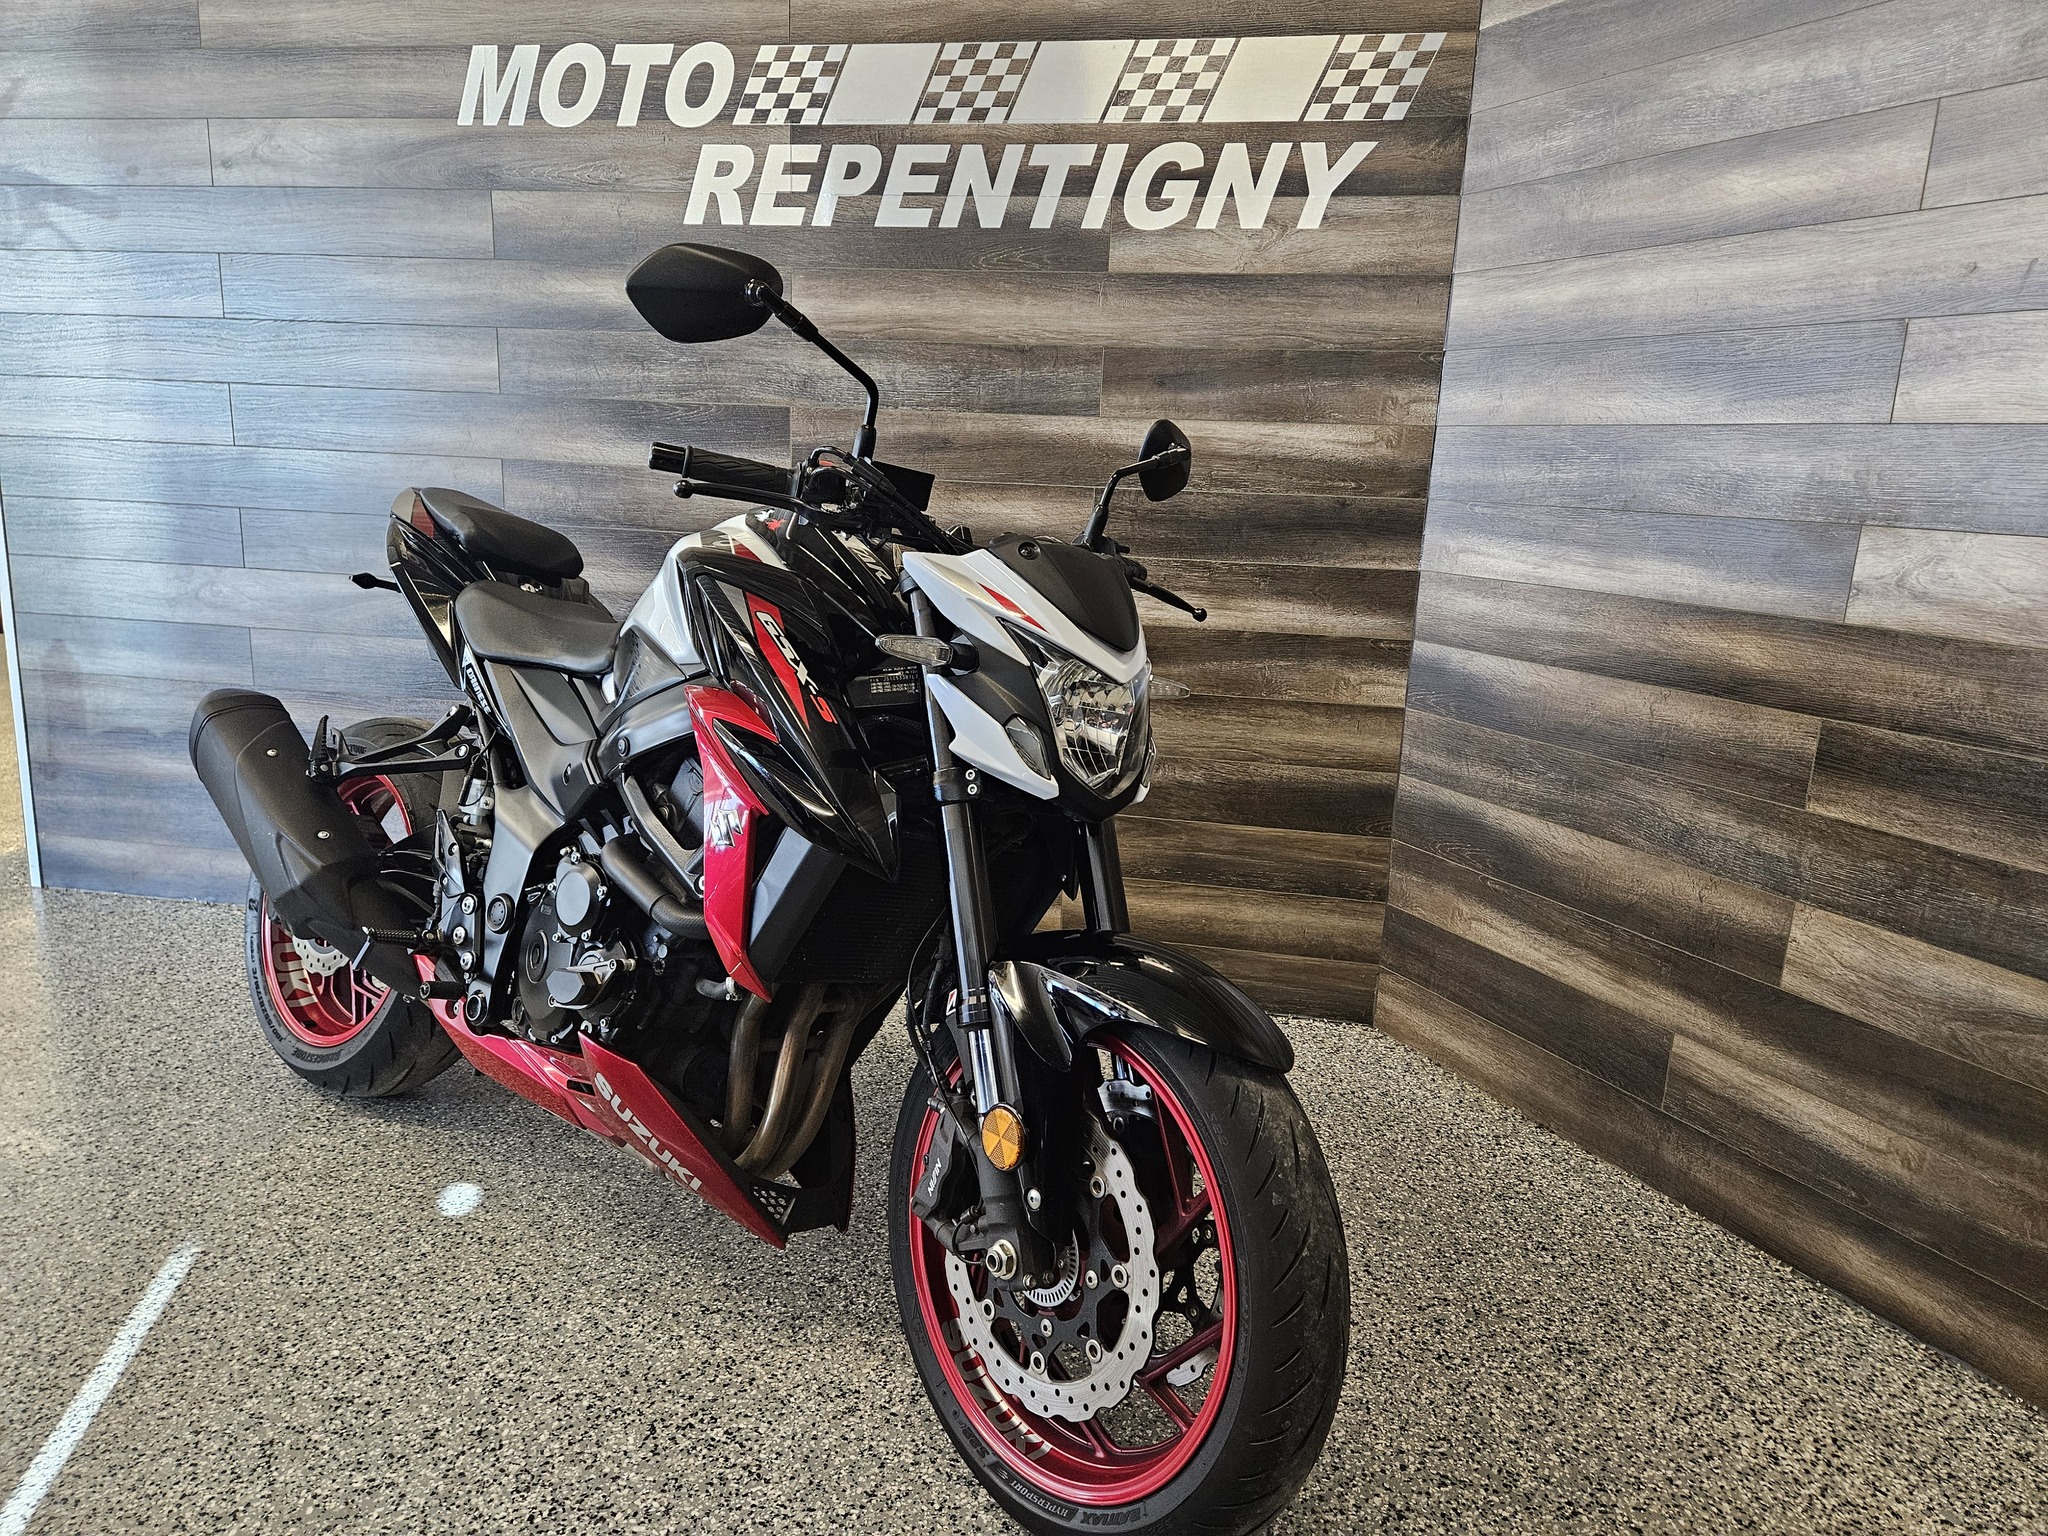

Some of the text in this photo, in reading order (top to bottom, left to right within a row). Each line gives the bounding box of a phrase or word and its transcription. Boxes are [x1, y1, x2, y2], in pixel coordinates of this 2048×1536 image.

[456, 42, 735, 128] MOTO
[683, 141, 1379, 230] REPENTIGNY
[756, 611, 838, 725] GSX-S
[594, 1072, 702, 1191] SUZUKI
[942, 1317, 1053, 1461] SUZUKI
[1010, 1480, 1069, 1517] HYPERSPORT
